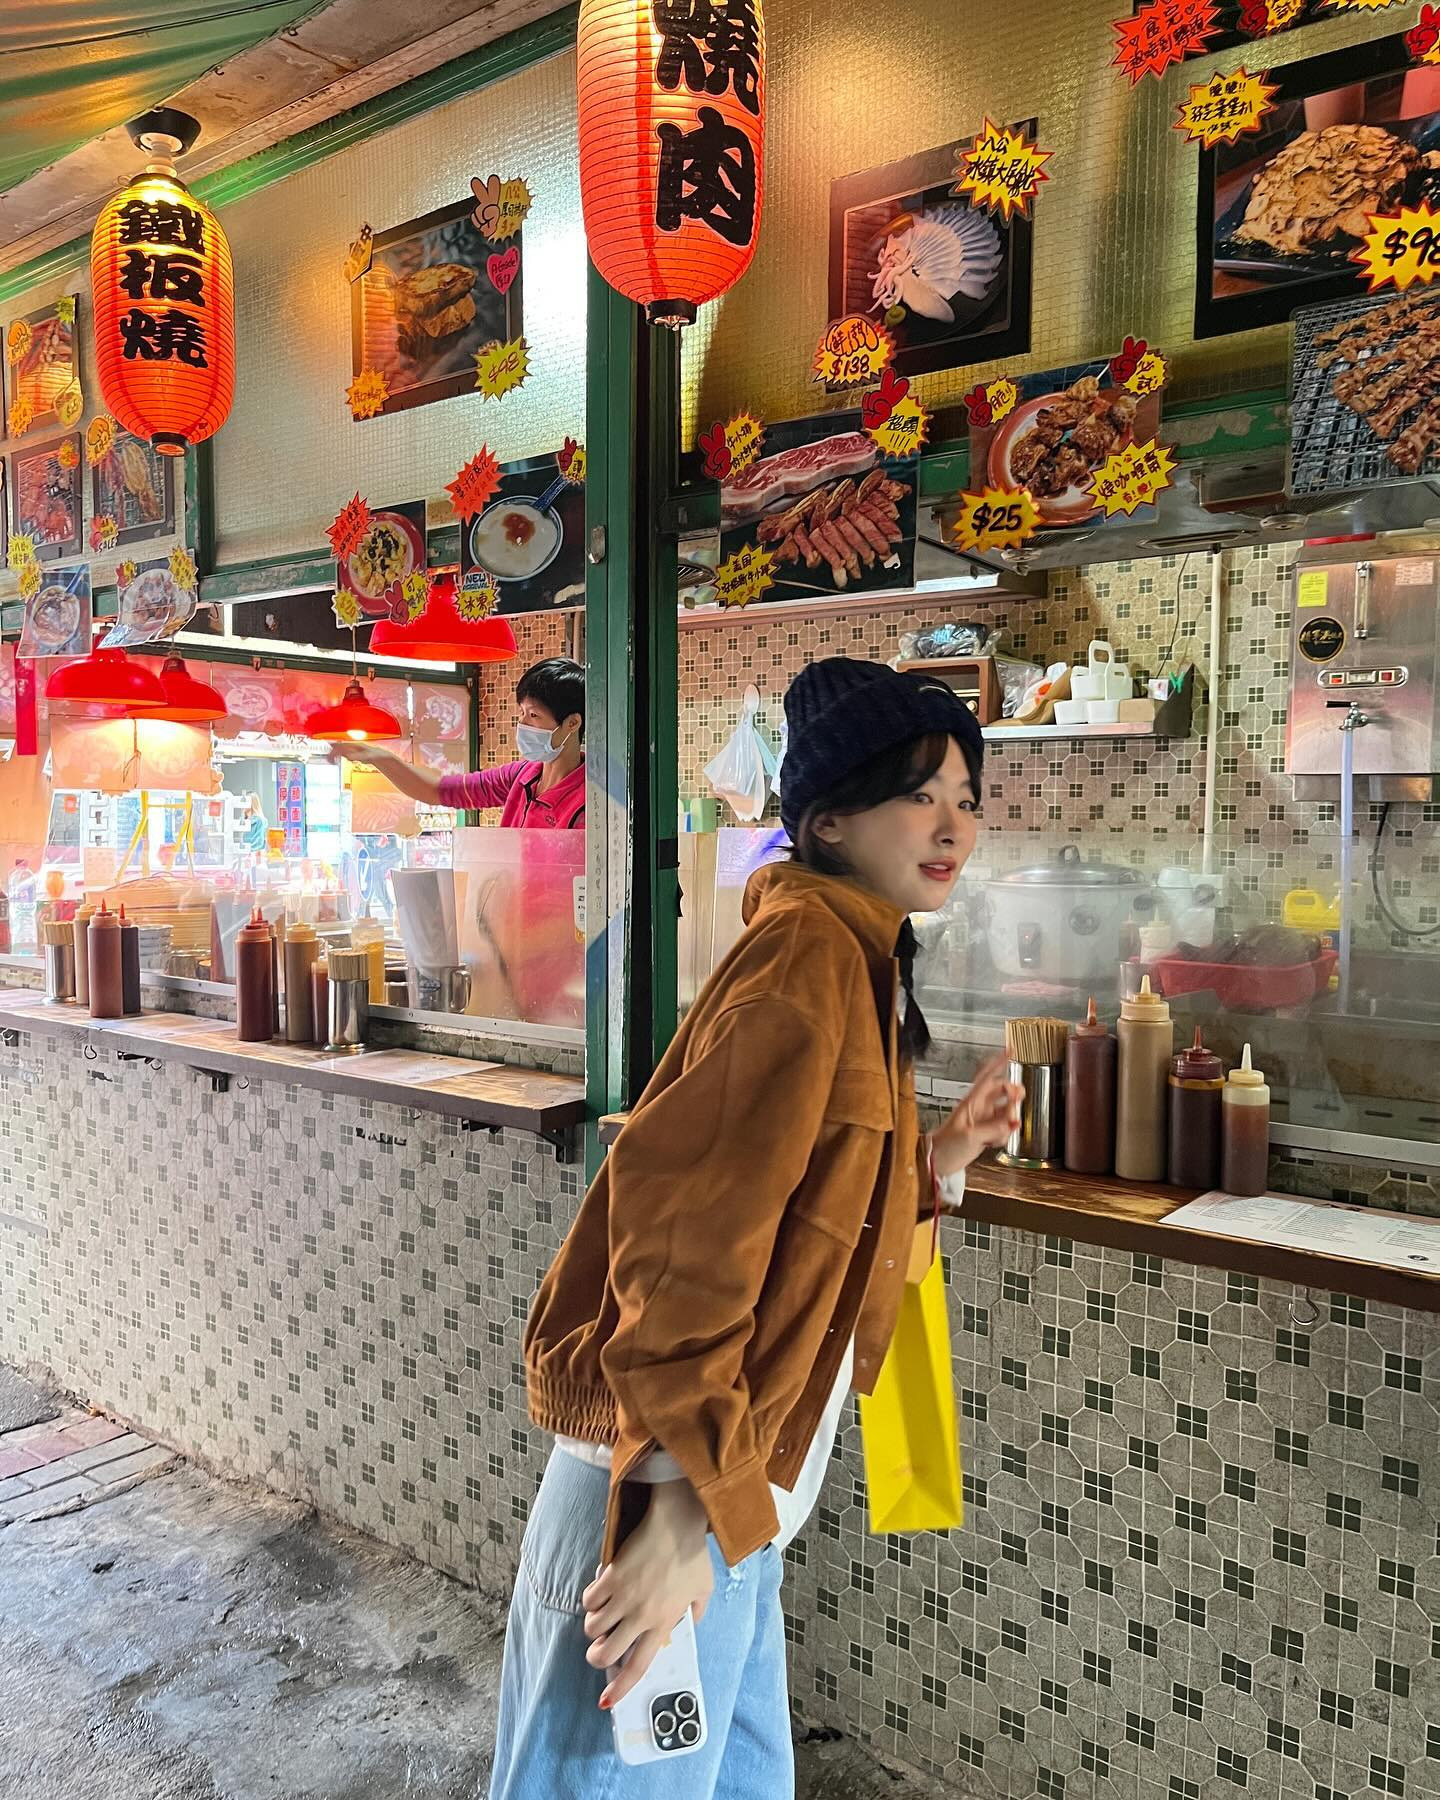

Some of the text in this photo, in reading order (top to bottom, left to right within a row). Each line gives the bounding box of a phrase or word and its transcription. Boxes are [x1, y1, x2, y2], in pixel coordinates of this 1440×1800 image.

[829, 353, 870, 380] $138
[971, 502, 1022, 537] $25
[466, 575, 487, 584] NEW
